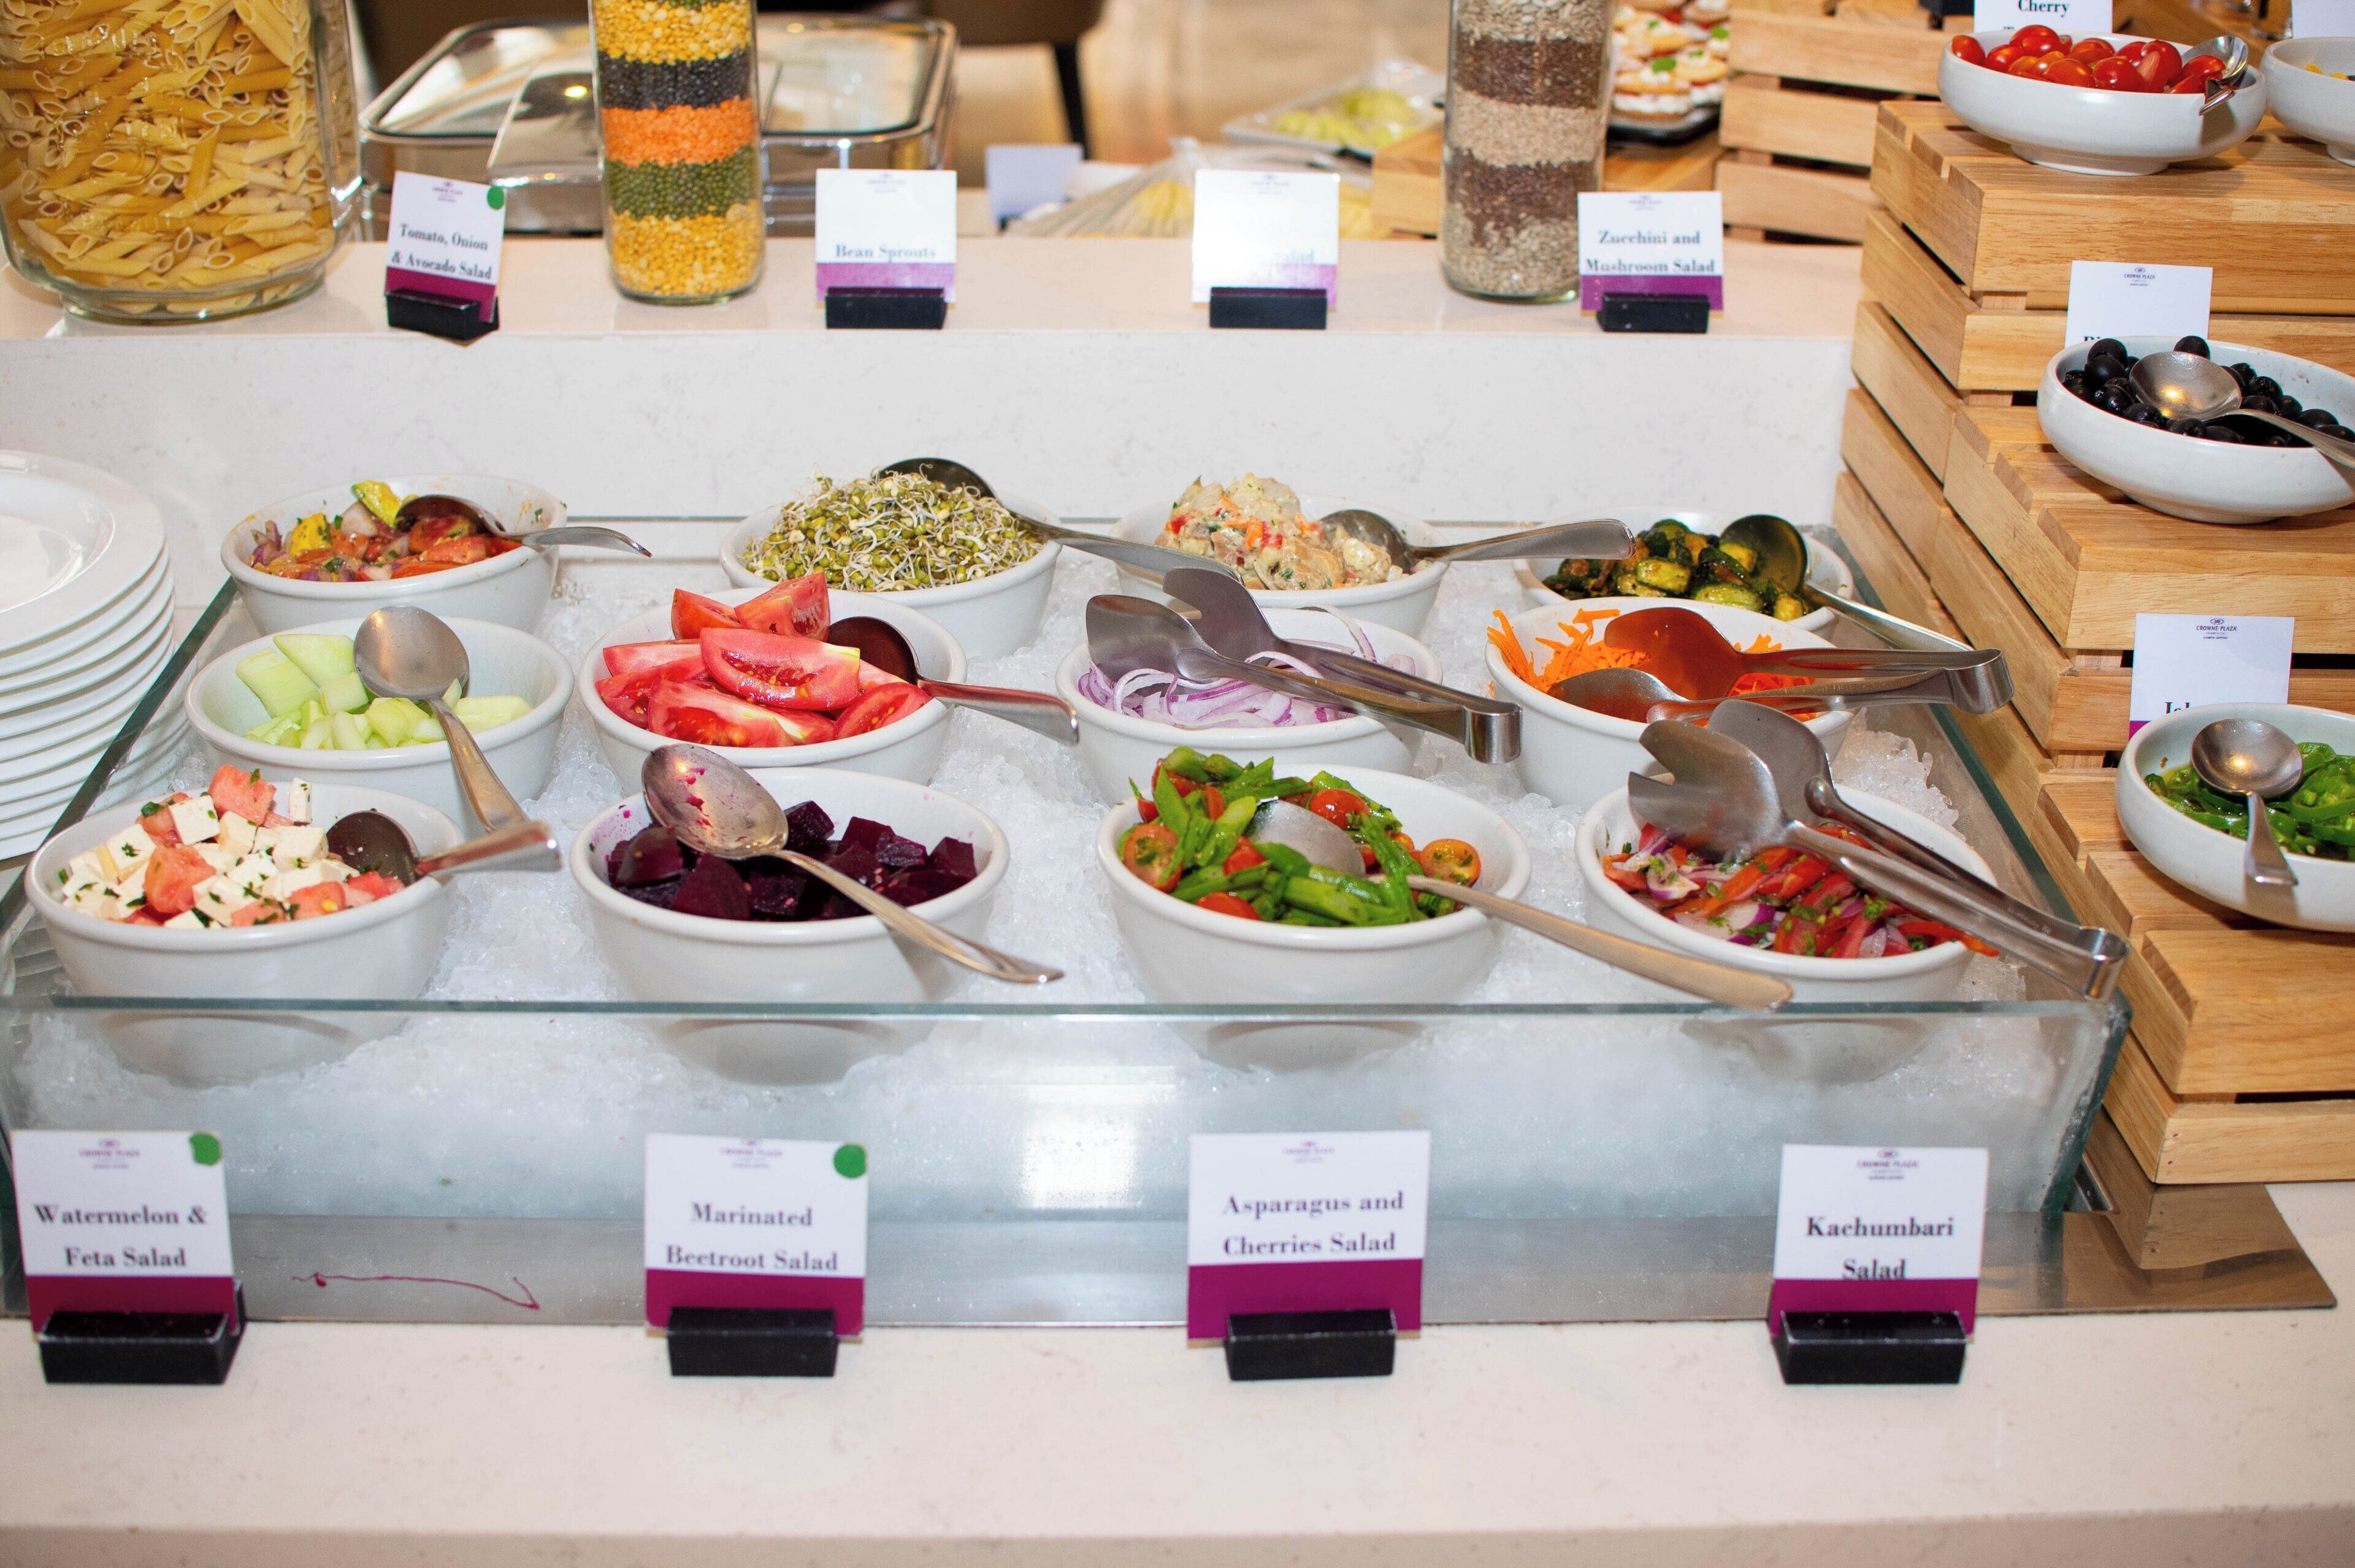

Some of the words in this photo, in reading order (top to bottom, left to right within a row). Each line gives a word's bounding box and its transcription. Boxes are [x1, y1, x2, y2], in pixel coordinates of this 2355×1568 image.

[2018, 0, 2070, 17] Cherry
[400, 223, 448, 245] Tomato,
[451, 232, 488, 250] Onion
[1598, 229, 1668, 244] Zucchini
[1672, 231, 1701, 244] and
[835, 244, 873, 258] Bean
[878, 245, 936, 263] Sprouts
[391, 251, 400, 263] &
[407, 252, 456, 273] Avocado
[459, 264, 492, 279] Salad
[1586, 258, 1668, 272] Mushroom
[1673, 258, 1715, 272] Salad
[34, 1203, 179, 1225] Watermelon
[186, 1204, 207, 1225] &
[691, 1201, 813, 1226] Marinated
[1222, 1194, 1351, 1220] Asparagus
[1358, 1190, 1404, 1210] and
[1806, 1215, 1955, 1237] Kachumbari
[1222, 1234, 1322, 1255] Cherries
[1329, 1231, 1396, 1253] Salad
[64, 1245, 116, 1267] Feta
[122, 1245, 187, 1268] Salad
[665, 1244, 765, 1269] Beetroot
[773, 1249, 838, 1272] Salad
[1842, 1258, 1907, 1280] Salad
